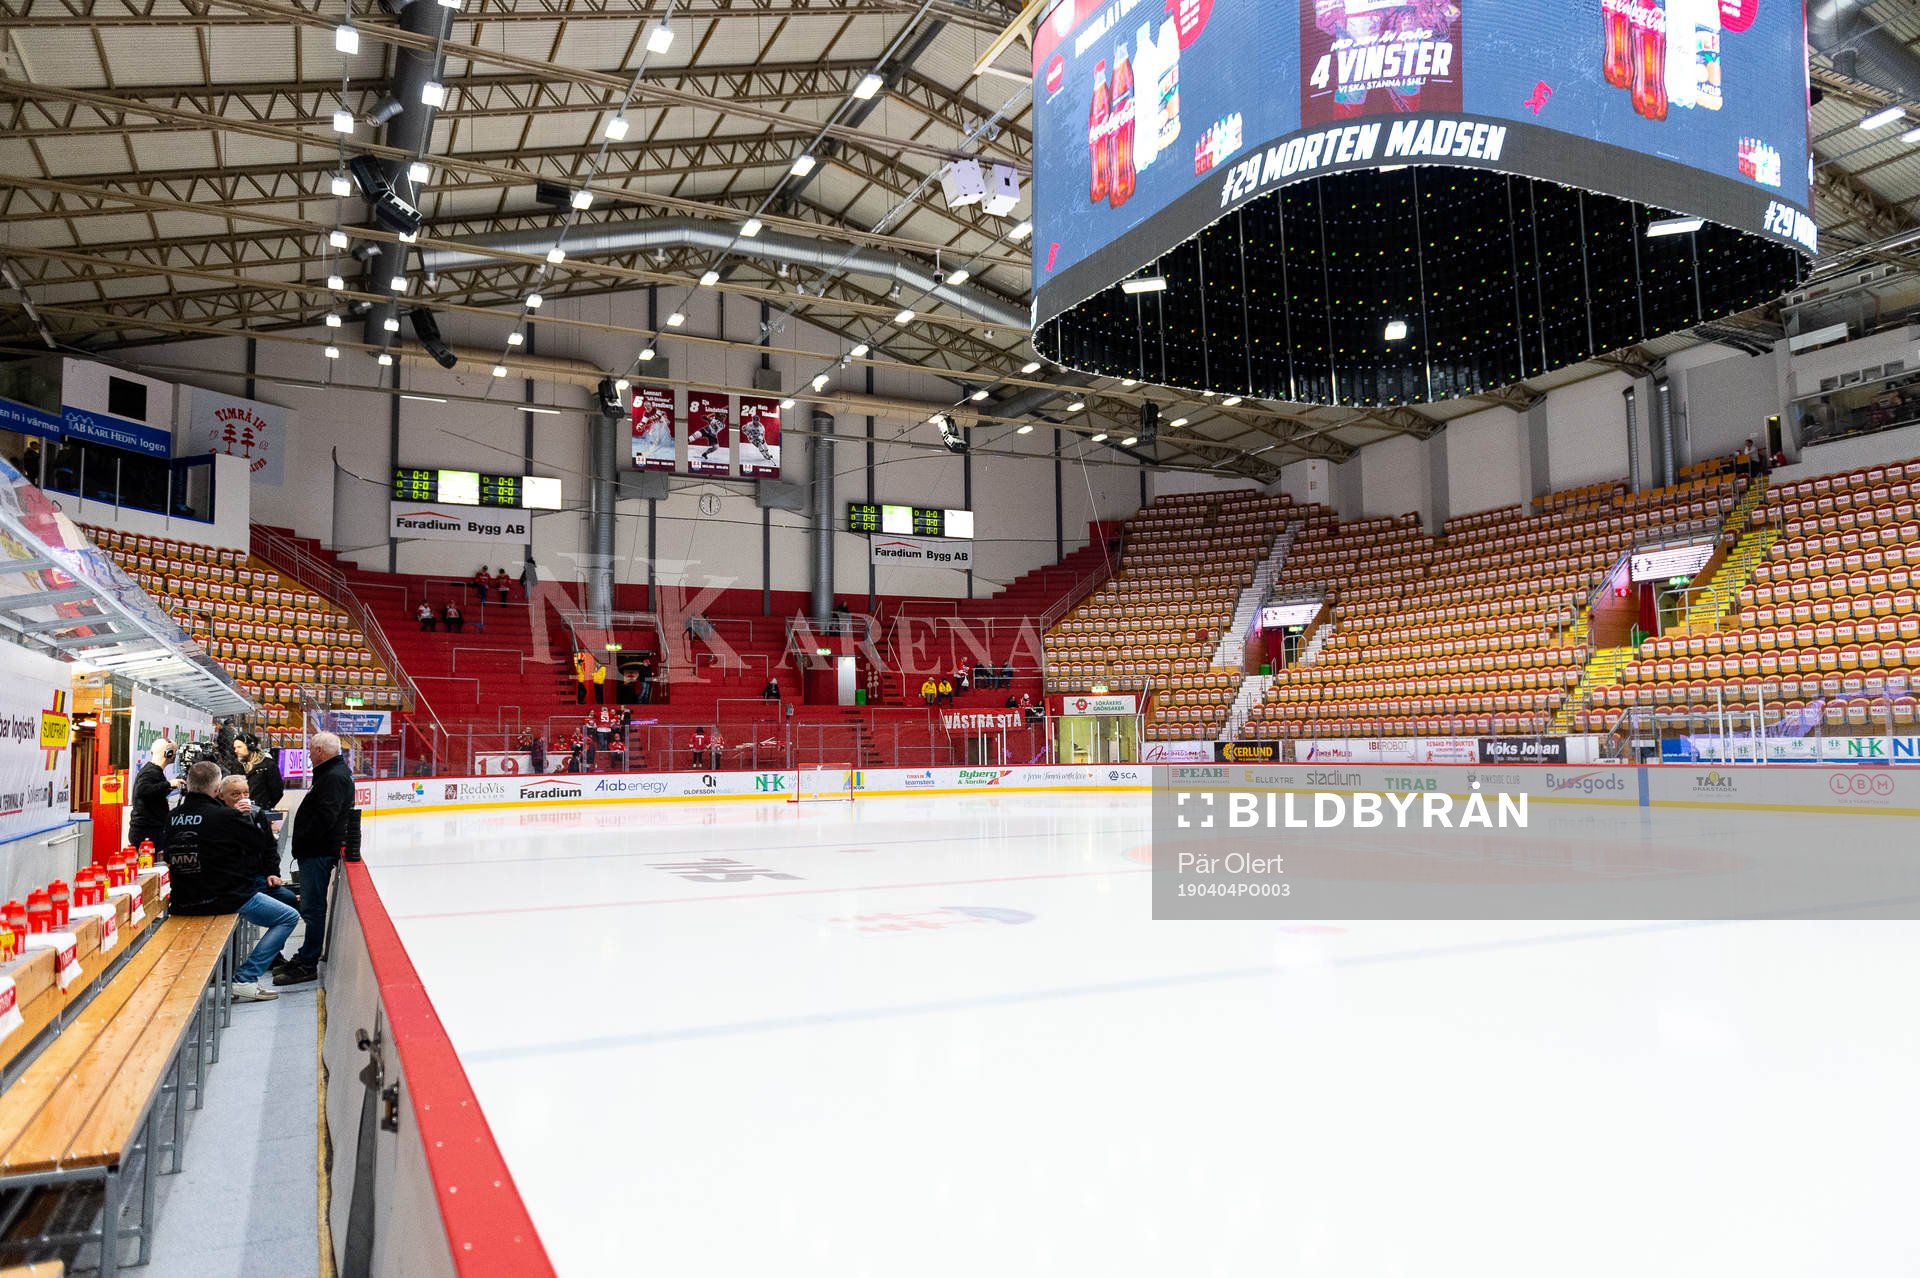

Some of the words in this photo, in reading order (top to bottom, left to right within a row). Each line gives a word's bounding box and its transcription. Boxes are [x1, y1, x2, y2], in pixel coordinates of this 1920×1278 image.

[1310, 54, 1331, 89] 4
[1337, 41, 1453, 85] VINSTER
[1221, 153, 1263, 208] #29
[1260, 122, 1382, 185] MORTEN
[1384, 119, 1507, 161] MADSEN
[1763, 200, 1795, 238] #29
[689, 401, 700, 413] 8
[741, 405, 757, 417] 24
[214, 407, 252, 423] TIMRÅ
[26, 416, 60, 433] värmen
[73, 422, 86, 433] AB
[87, 424, 109, 439] KARL
[110, 430, 137, 446] HEDIN
[140, 439, 166, 453] logen
[396, 517, 461, 531] Faradium
[467, 522, 501, 535] Bygg
[506, 524, 525, 535] AB
[875, 547, 922, 558] Faradium
[926, 550, 951, 561] Bygg
[954, 552, 968, 561] AB
[774, 608, 1042, 675] ARENA
[944, 712, 994, 729] VÄSTRA
[997, 711, 1022, 727] STÅ
[12, 714, 35, 744] logistik
[1486, 743, 1517, 755] Köks
[1520, 743, 1559, 755] Johan
[959, 770, 997, 779] Byberg
[1179, 768, 1223, 778] PEAB
[1306, 769, 1362, 787] stadium
[460, 783, 505, 795] RedoVis
[1384, 777, 1438, 791] TIRAB
[1546, 773, 1625, 793] Bussgods
[1696, 776, 1733, 787] TAXI
[387, 792, 415, 803] Hellbergs
[520, 786, 582, 799] Faradium
[171, 814, 203, 827] VÄRD
